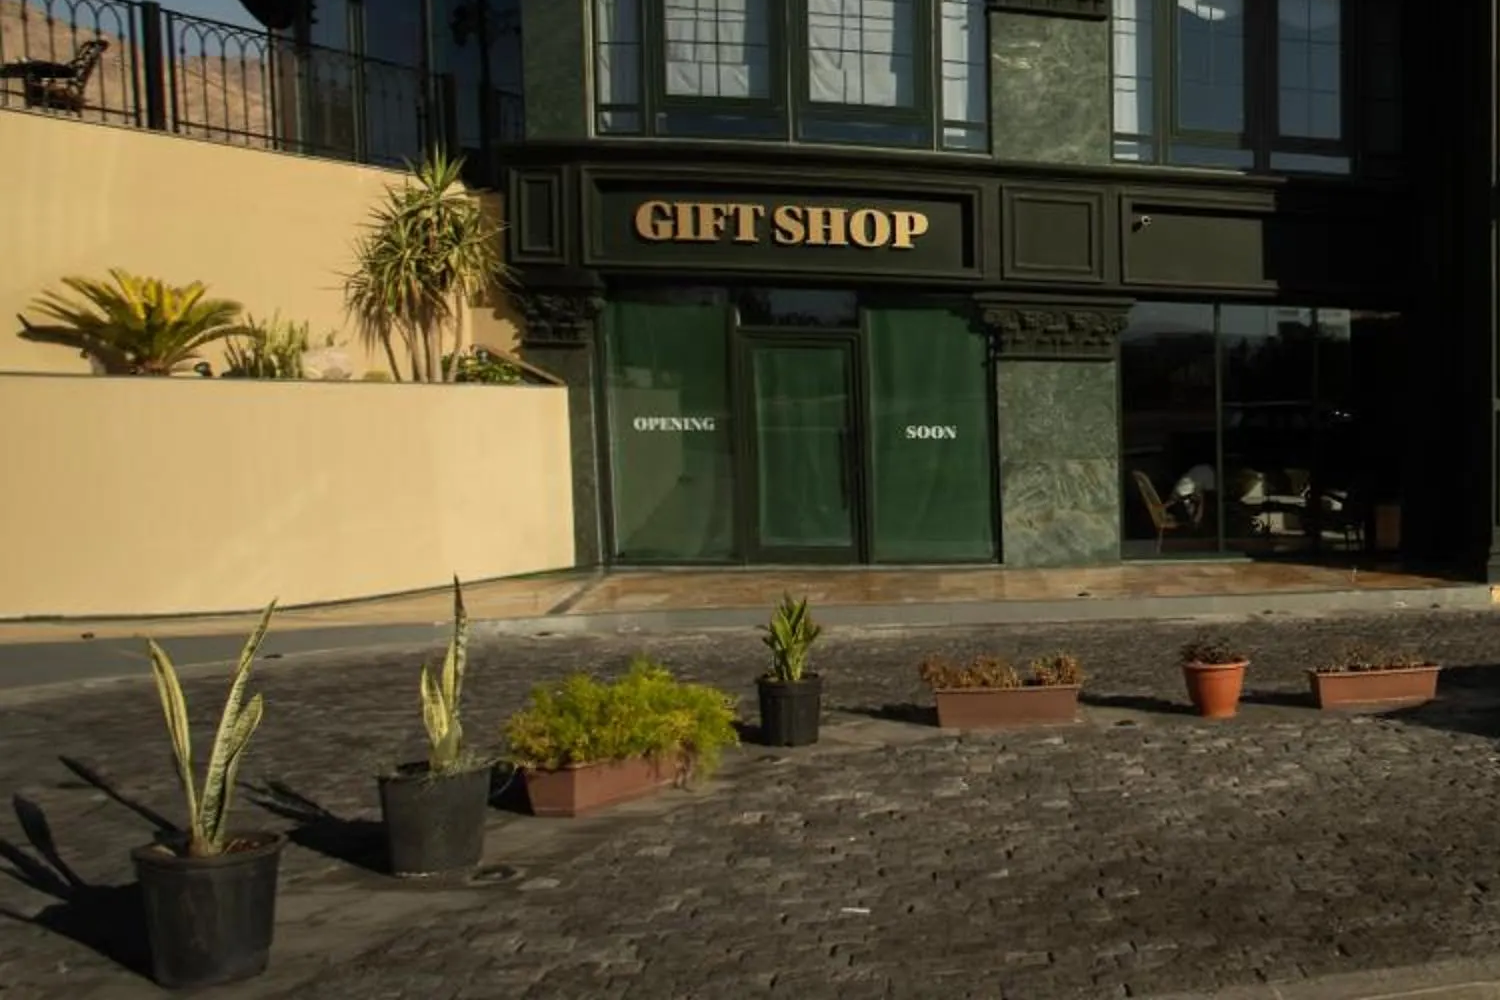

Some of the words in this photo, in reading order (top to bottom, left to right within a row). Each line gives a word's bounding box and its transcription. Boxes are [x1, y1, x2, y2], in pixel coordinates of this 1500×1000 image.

[634, 199, 766, 243] GIFT
[773, 203, 930, 250] SHOP
[632, 415, 716, 434] OPENING
[905, 423, 958, 440] SOON
